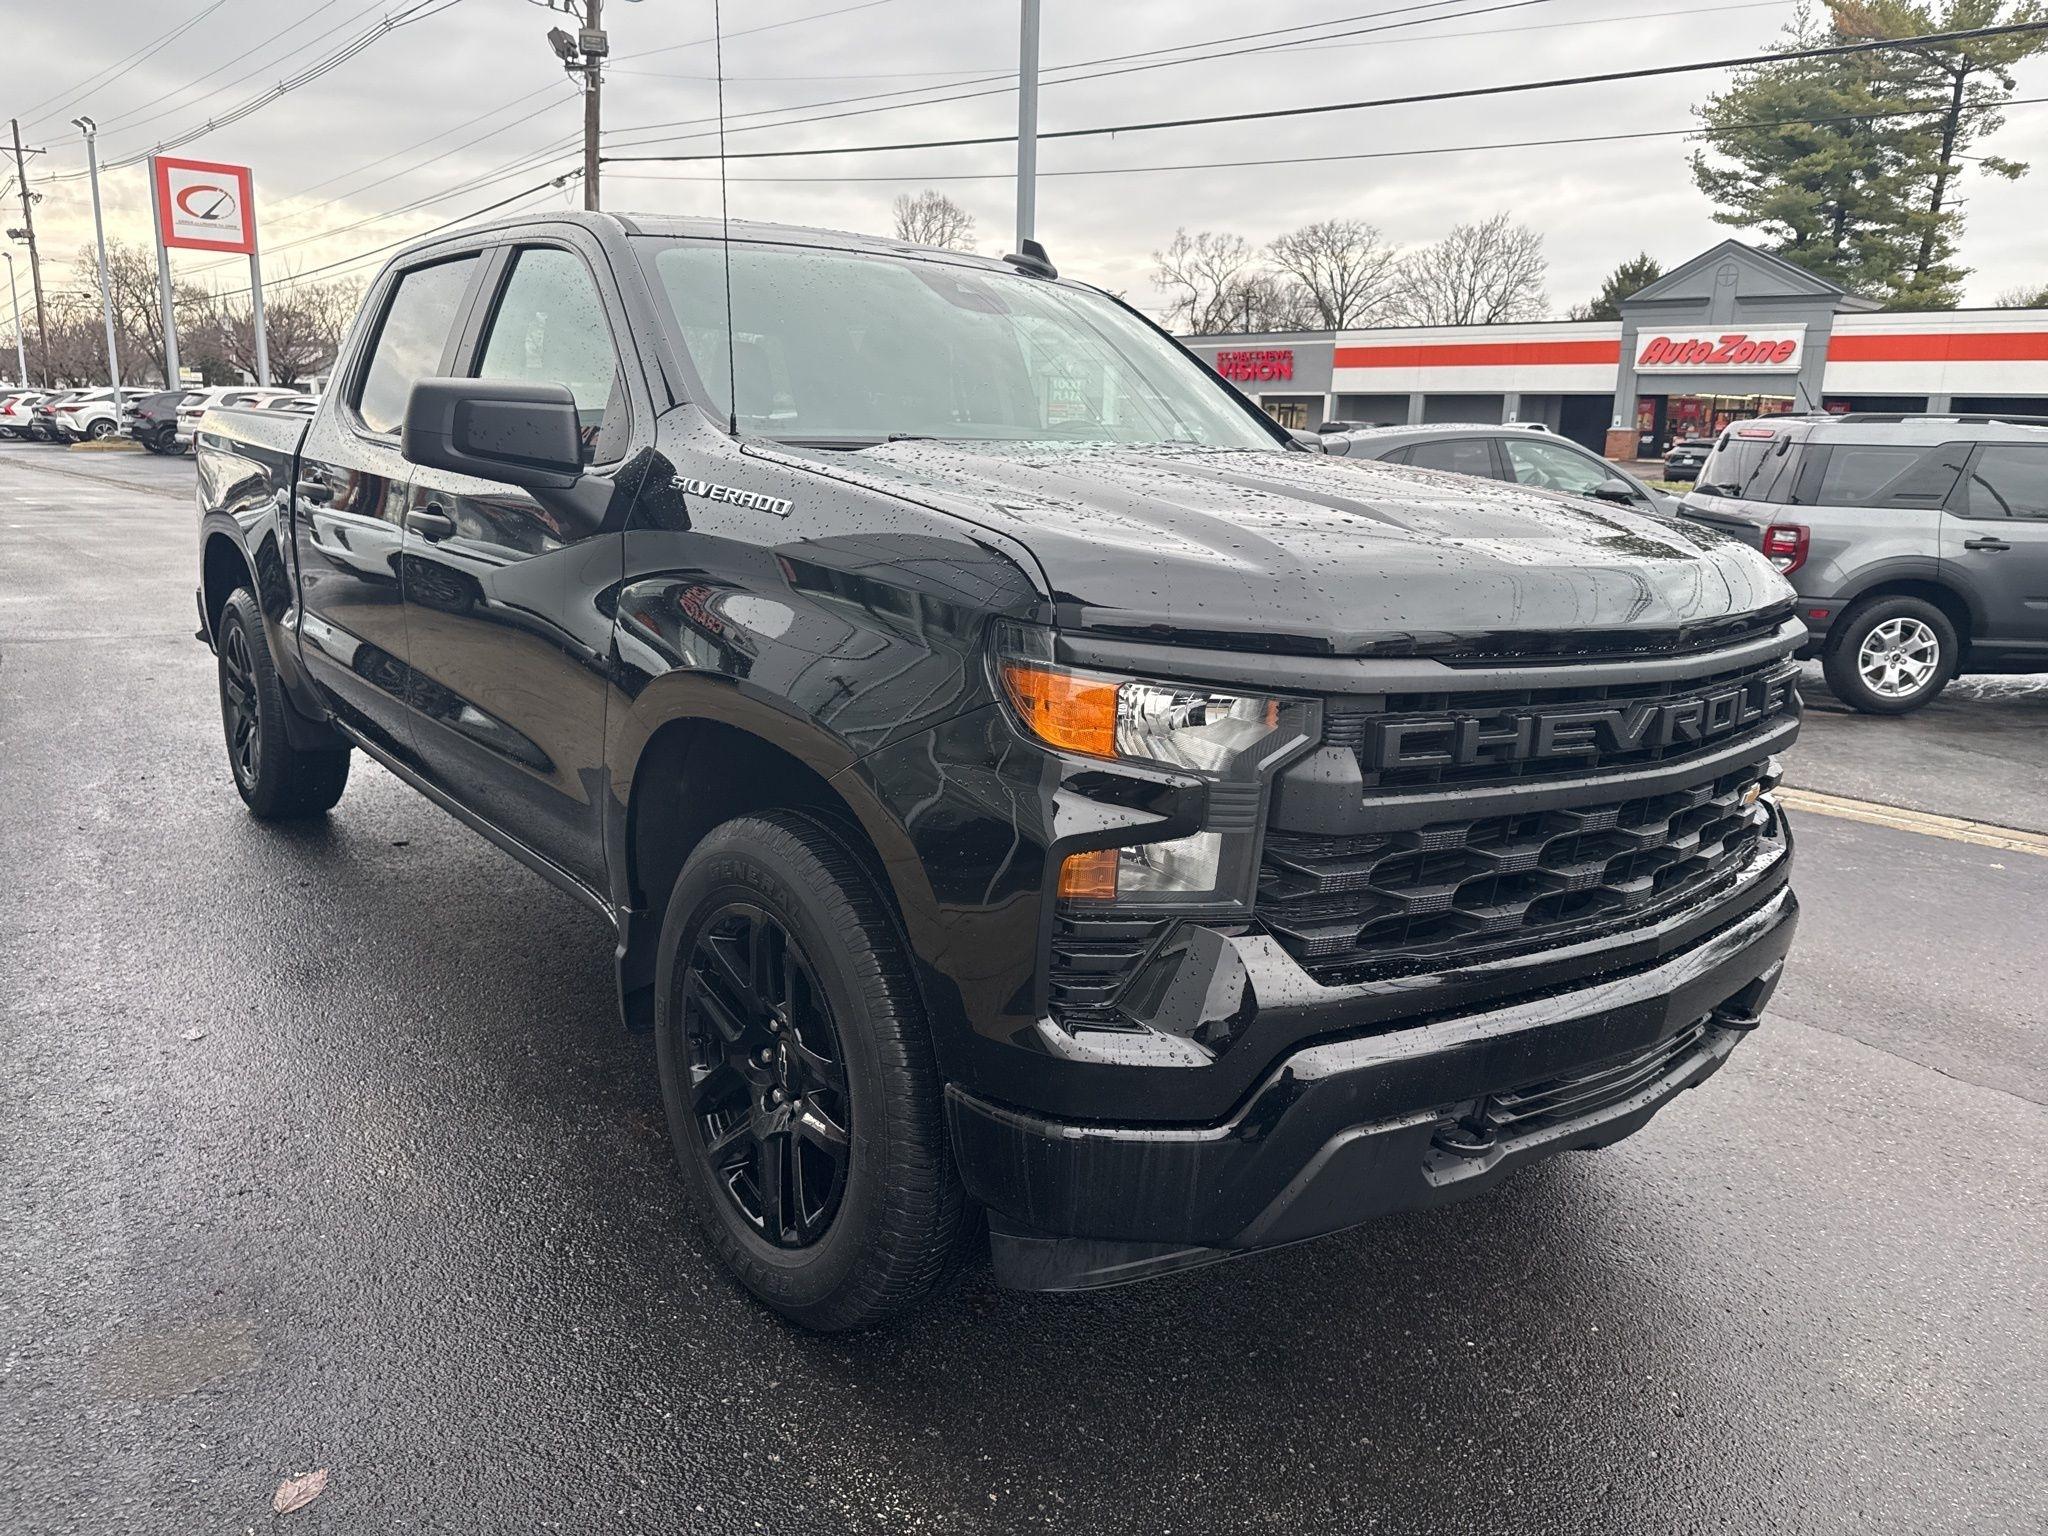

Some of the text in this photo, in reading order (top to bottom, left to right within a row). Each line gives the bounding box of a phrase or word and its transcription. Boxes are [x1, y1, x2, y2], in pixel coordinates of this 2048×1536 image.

[1638, 335, 1797, 365] AutoZone
[1217, 361, 1294, 382] VISION
[668, 475, 796, 518] SILVERADO
